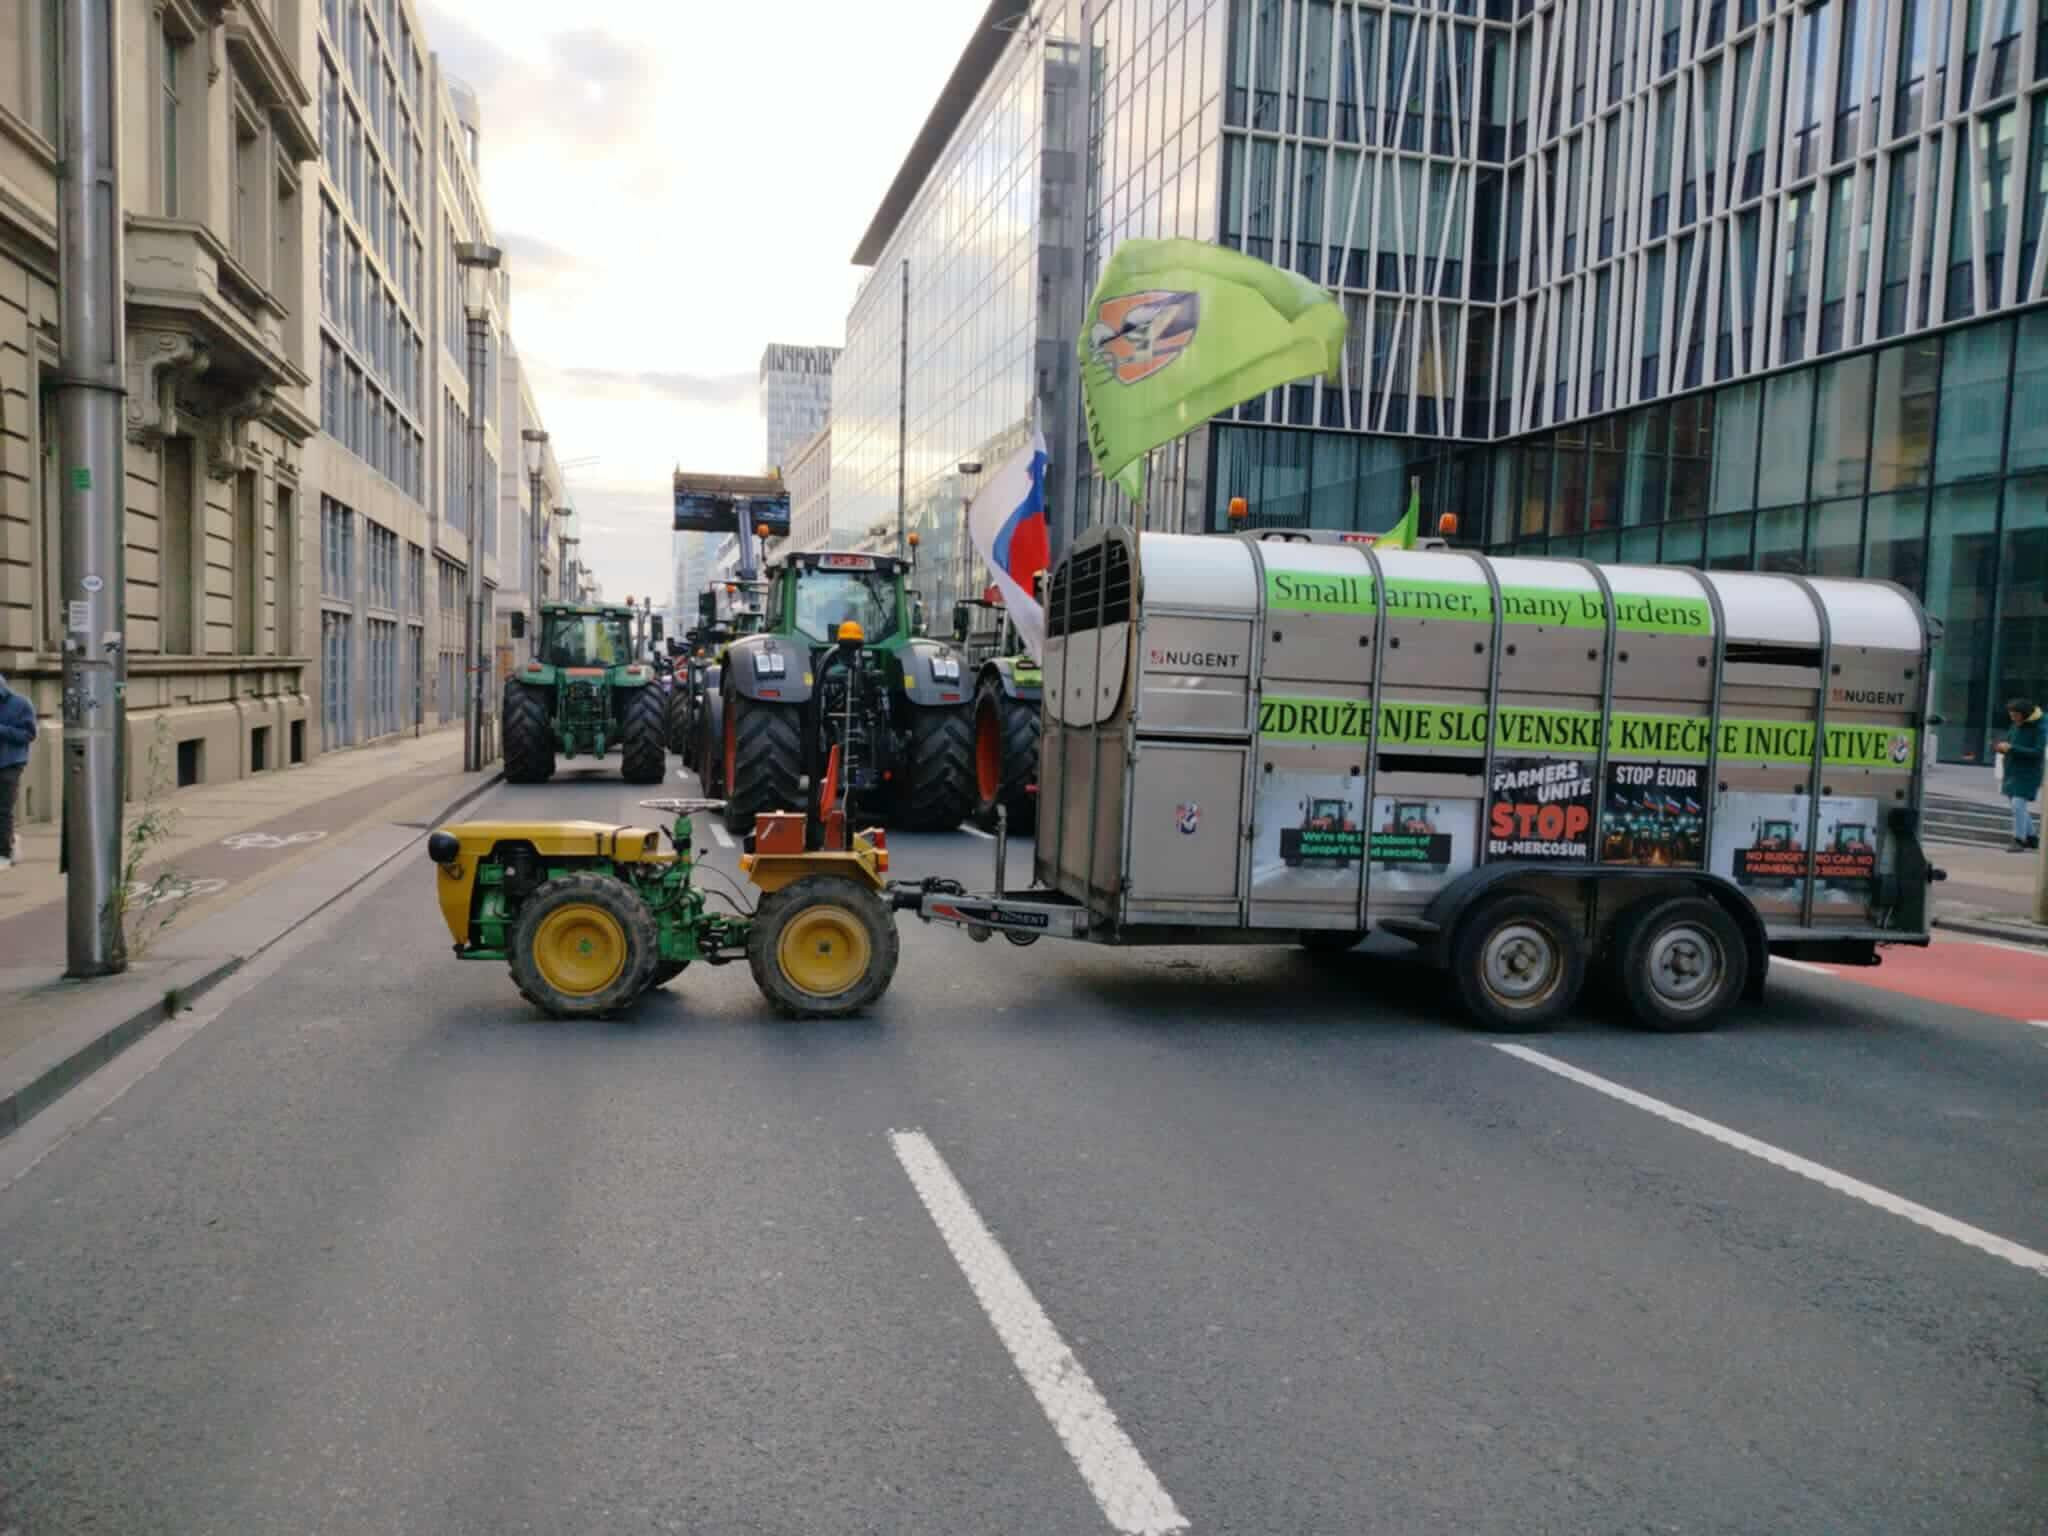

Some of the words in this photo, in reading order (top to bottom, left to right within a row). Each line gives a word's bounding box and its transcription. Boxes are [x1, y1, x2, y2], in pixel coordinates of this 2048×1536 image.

[1274, 575, 1358, 603] Small
[1490, 596, 1571, 625] many
[1578, 593, 1702, 626] burdens
[1166, 652, 1240, 668] NUGENT
[1845, 689, 1905, 705] NUGENT
[1259, 702, 1431, 742] ZDRUŽENJE
[1439, 711, 1612, 747] SLOVENSKE
[1621, 719, 1738, 753] KMEČKE
[1744, 726, 1888, 760] INICIATIVE
[1494, 762, 1579, 791] FARMERS
[1616, 766, 1653, 785] STOP
[1657, 767, 1697, 787] EUDR
[1537, 778, 1592, 803] UNITE
[1491, 802, 1589, 840] STOP
[1490, 840, 1586, 857] EU-MERCOSUR
